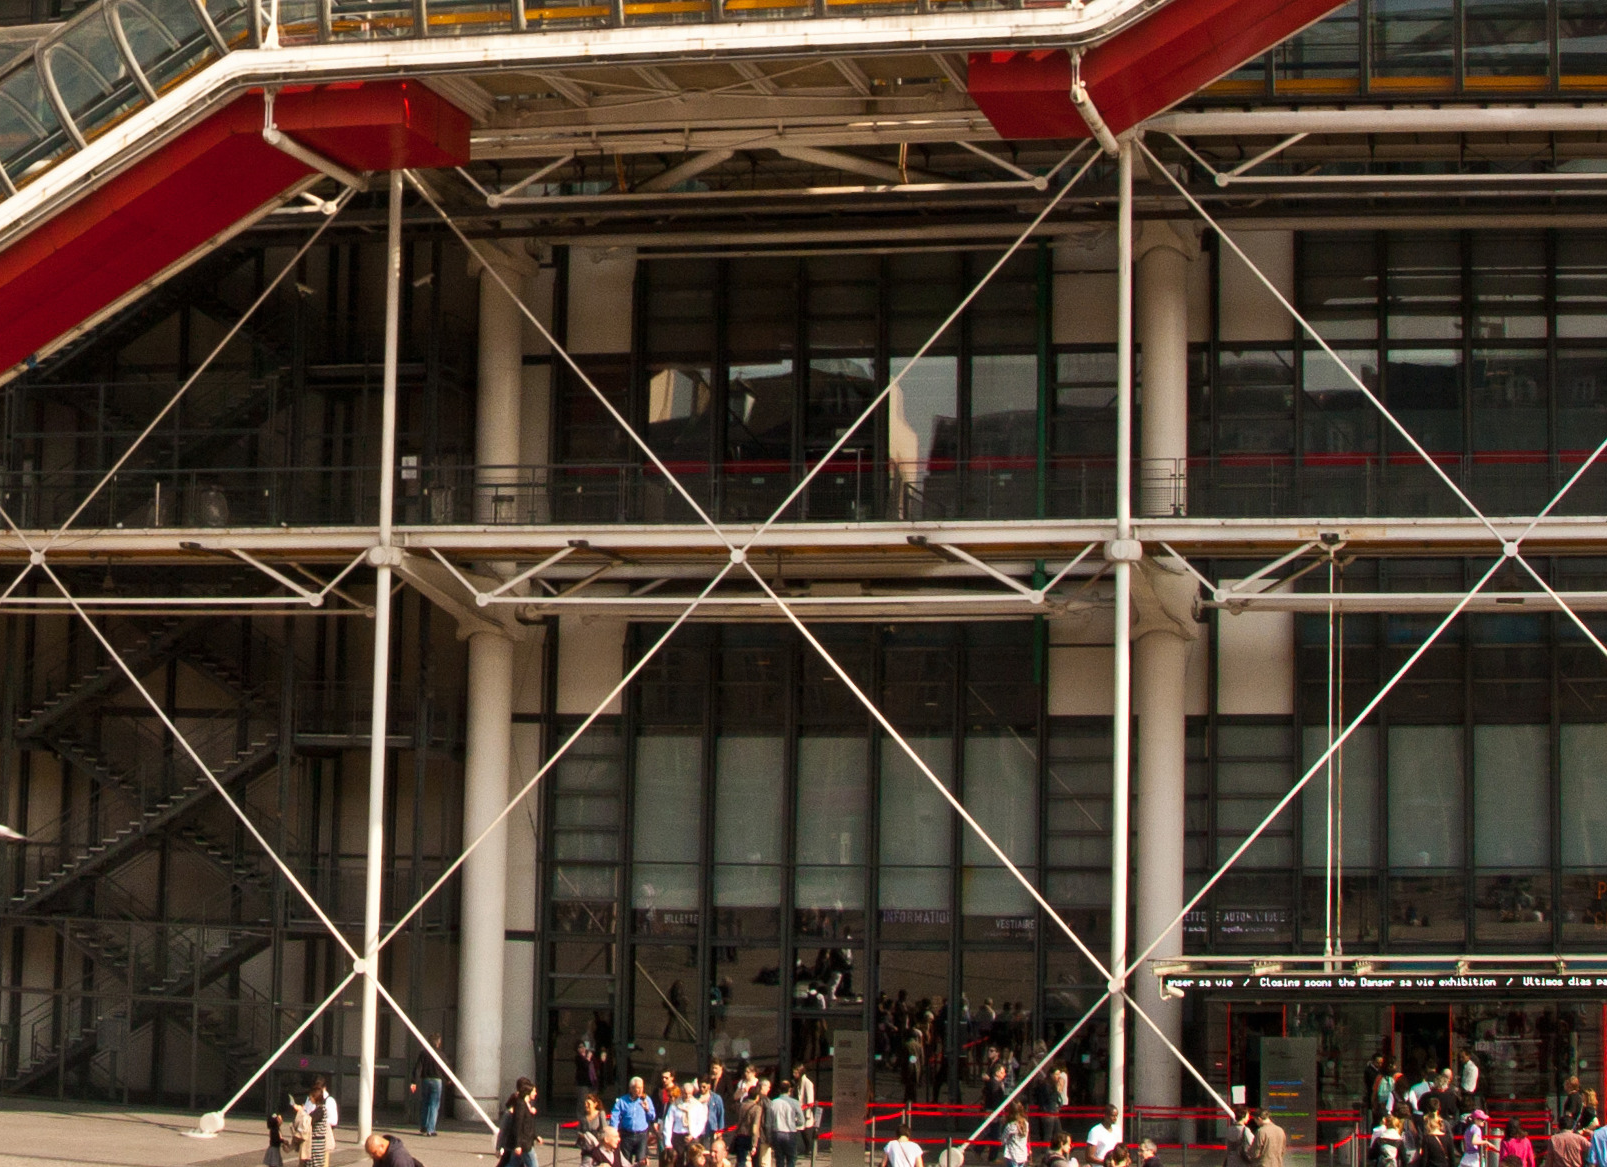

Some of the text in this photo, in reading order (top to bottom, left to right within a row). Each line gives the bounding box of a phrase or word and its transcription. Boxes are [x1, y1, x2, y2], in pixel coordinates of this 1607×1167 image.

[883, 911, 951, 923] INFORMATIO
[1215, 977, 1234, 987] vie
[1338, 977, 1355, 987] the
[1360, 977, 1395, 987] Danser
[1399, 979, 1412, 987] sa
[1416, 977, 1434, 987] vie
[1439, 977, 1497, 987] exhibition
